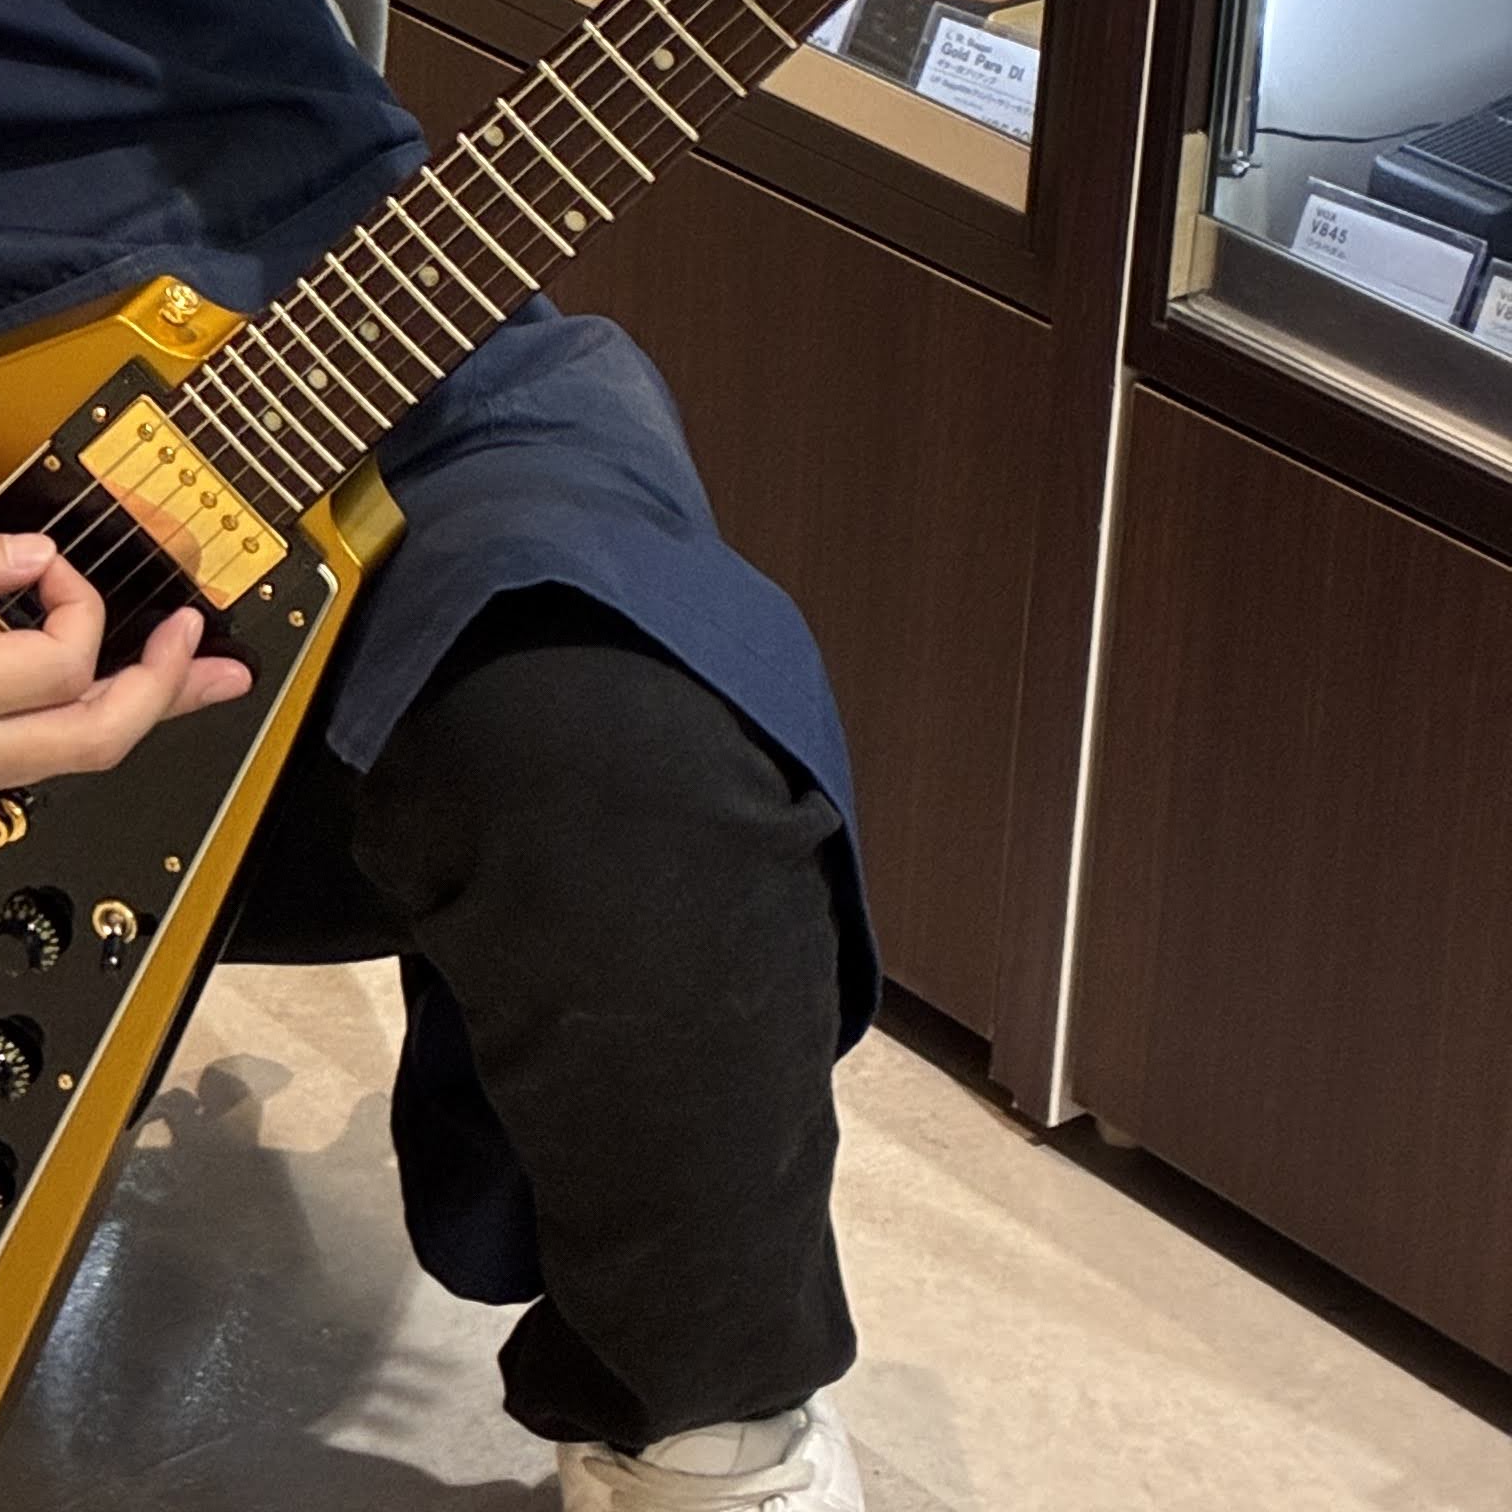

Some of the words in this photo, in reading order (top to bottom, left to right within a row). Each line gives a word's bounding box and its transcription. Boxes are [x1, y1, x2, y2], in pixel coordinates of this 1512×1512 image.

[941, 41, 970, 63] Gold
[974, 53, 1003, 75] Para
[1310, 218, 1349, 245] V845
